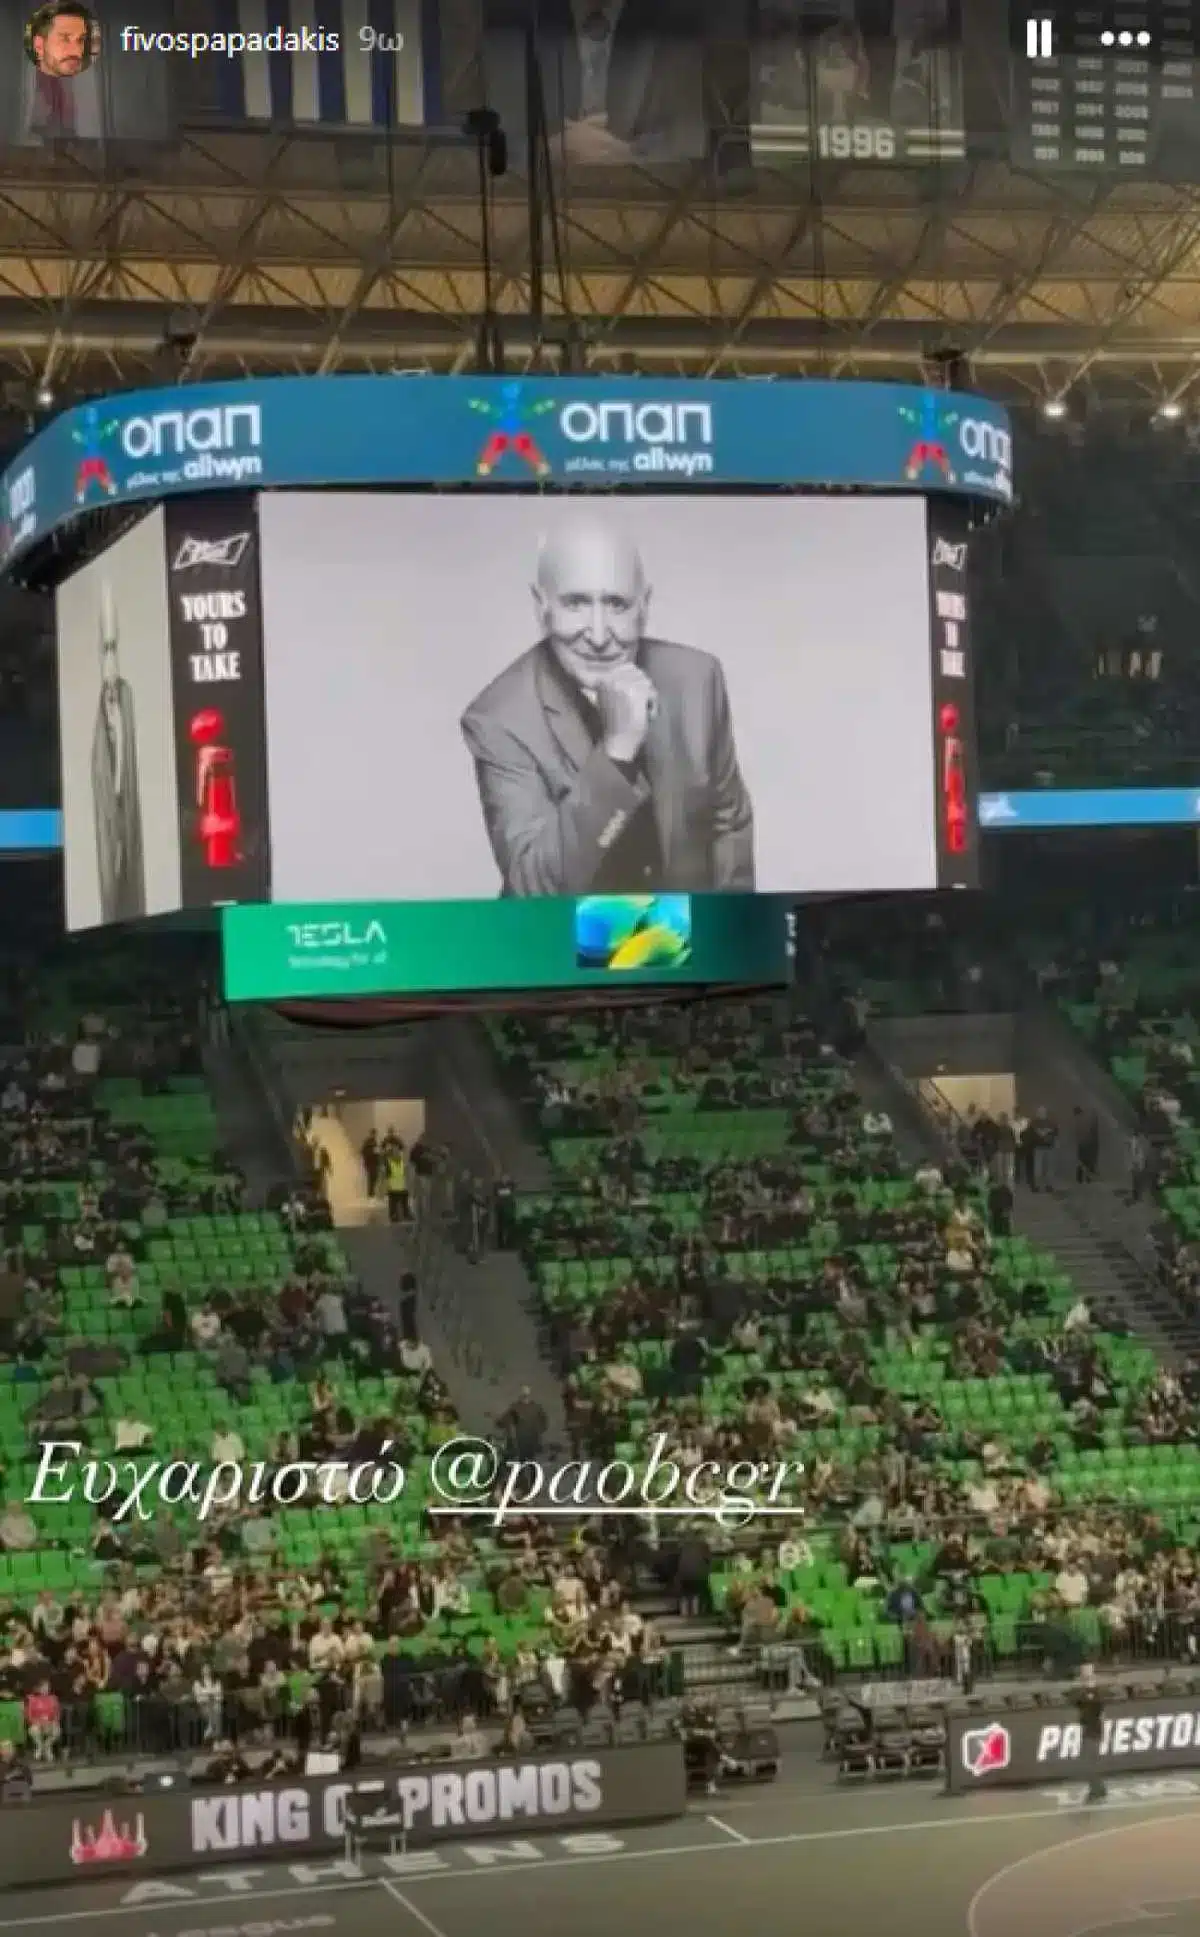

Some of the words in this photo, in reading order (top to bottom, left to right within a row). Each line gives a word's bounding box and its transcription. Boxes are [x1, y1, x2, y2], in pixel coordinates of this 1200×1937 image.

[817, 124, 896, 160] 1996
[180, 590, 246, 622] YOURS
[201, 622, 228, 651] TO
[190, 651, 242, 683] TAKE
[285, 919, 388, 949] TESLA
[191, 1787, 311, 1853] KING
[397, 1759, 602, 1830] PROMOS
[119, 1832, 626, 1905] ATHENS
